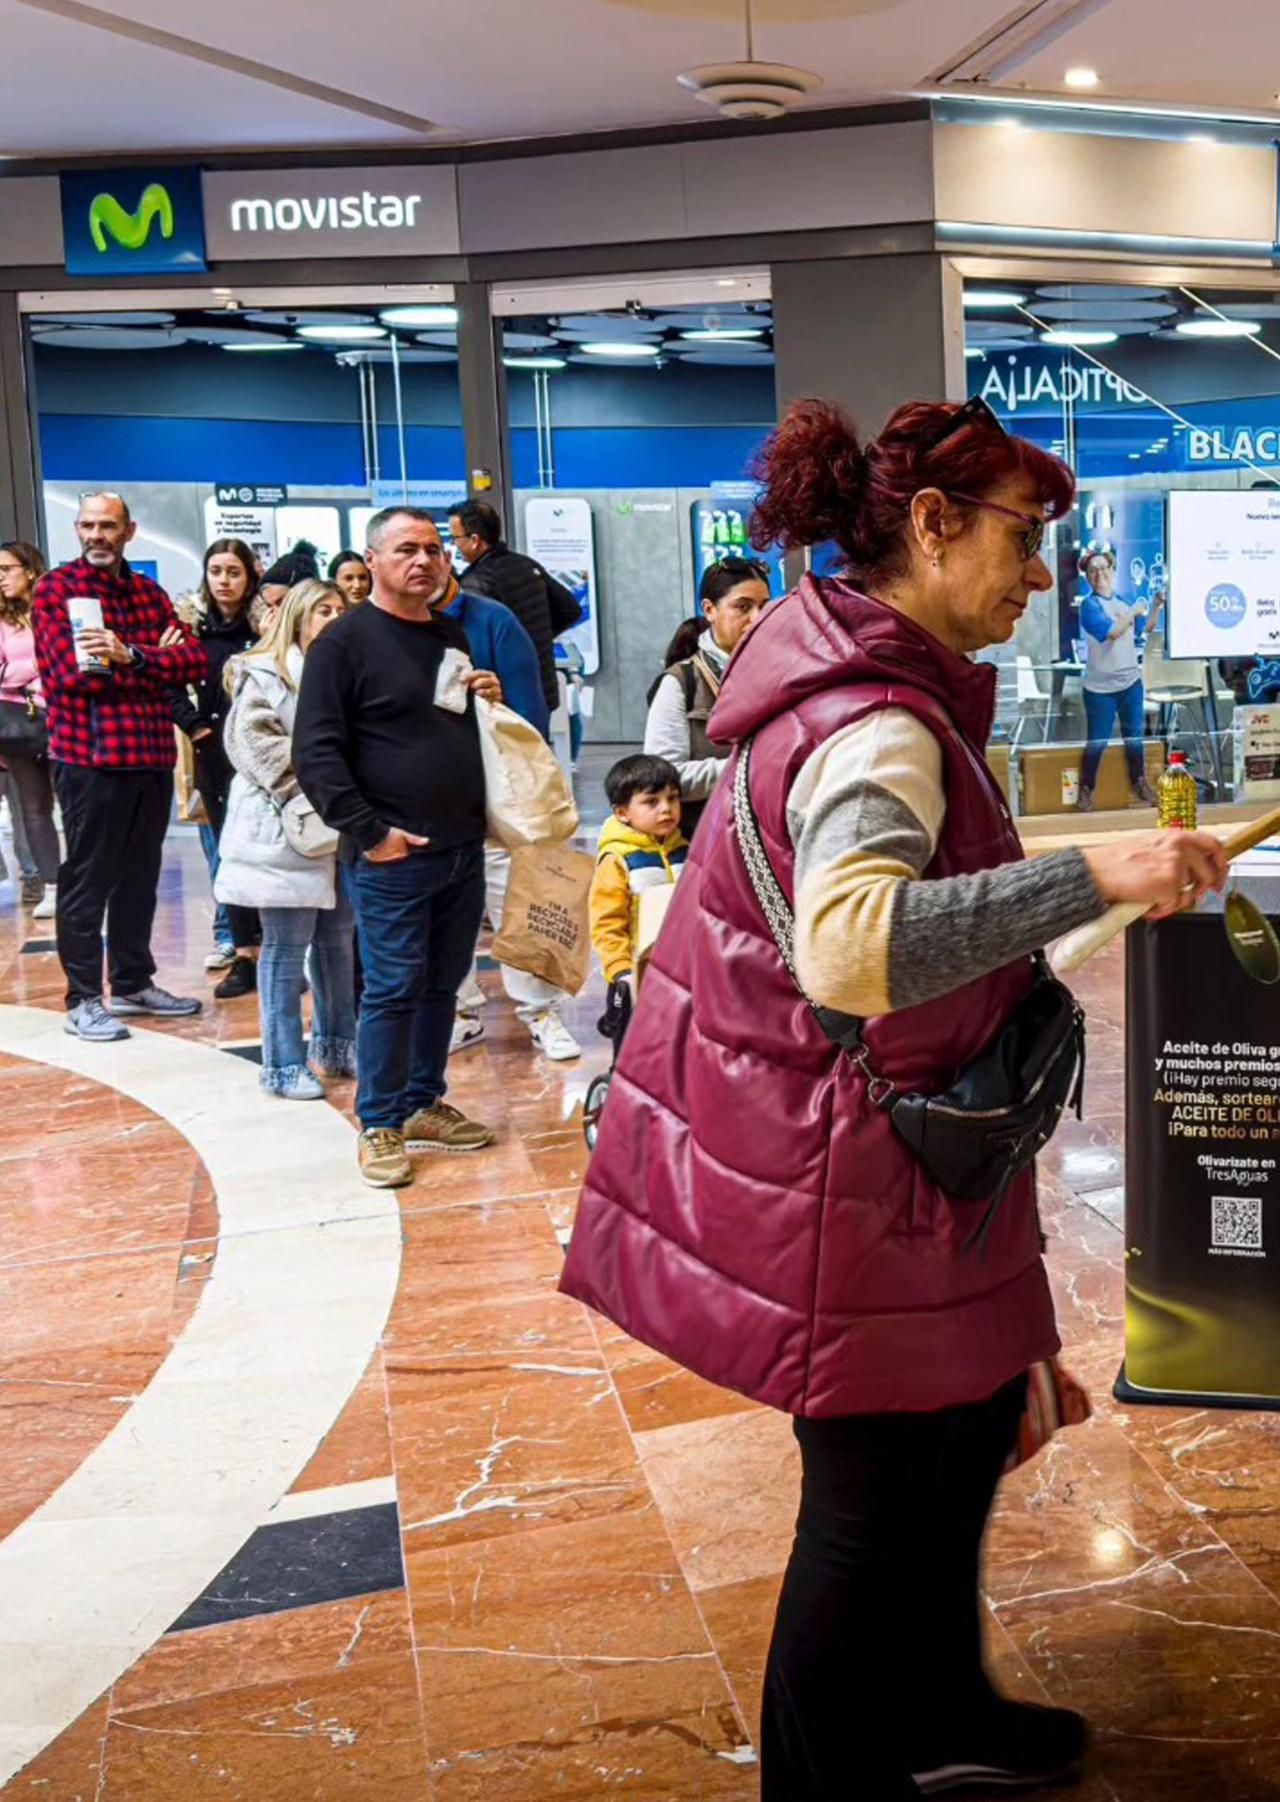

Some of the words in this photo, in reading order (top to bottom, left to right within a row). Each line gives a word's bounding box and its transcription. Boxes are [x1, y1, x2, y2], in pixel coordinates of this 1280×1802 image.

[230, 191, 421, 231] movistar
[1163, 1040, 1209, 1054] Aceite
[1211, 1041, 1230, 1055] de
[1232, 1042, 1266, 1056] Oliva
[1155, 1058, 1164, 1071] y
[1166, 1056, 1222, 1070] muchos
[1201, 1073, 1250, 1088] premio
[1154, 1088, 1219, 1106] Además,
[1171, 1106, 1229, 1121] ACEITE
[1231, 1107, 1253, 1121] DE
[1211, 1123, 1247, 1139] todo
[1249, 1127, 1269, 1139] un
[1260, 1159, 1277, 1168] en
[1205, 1167, 1269, 1187] TresAguas
